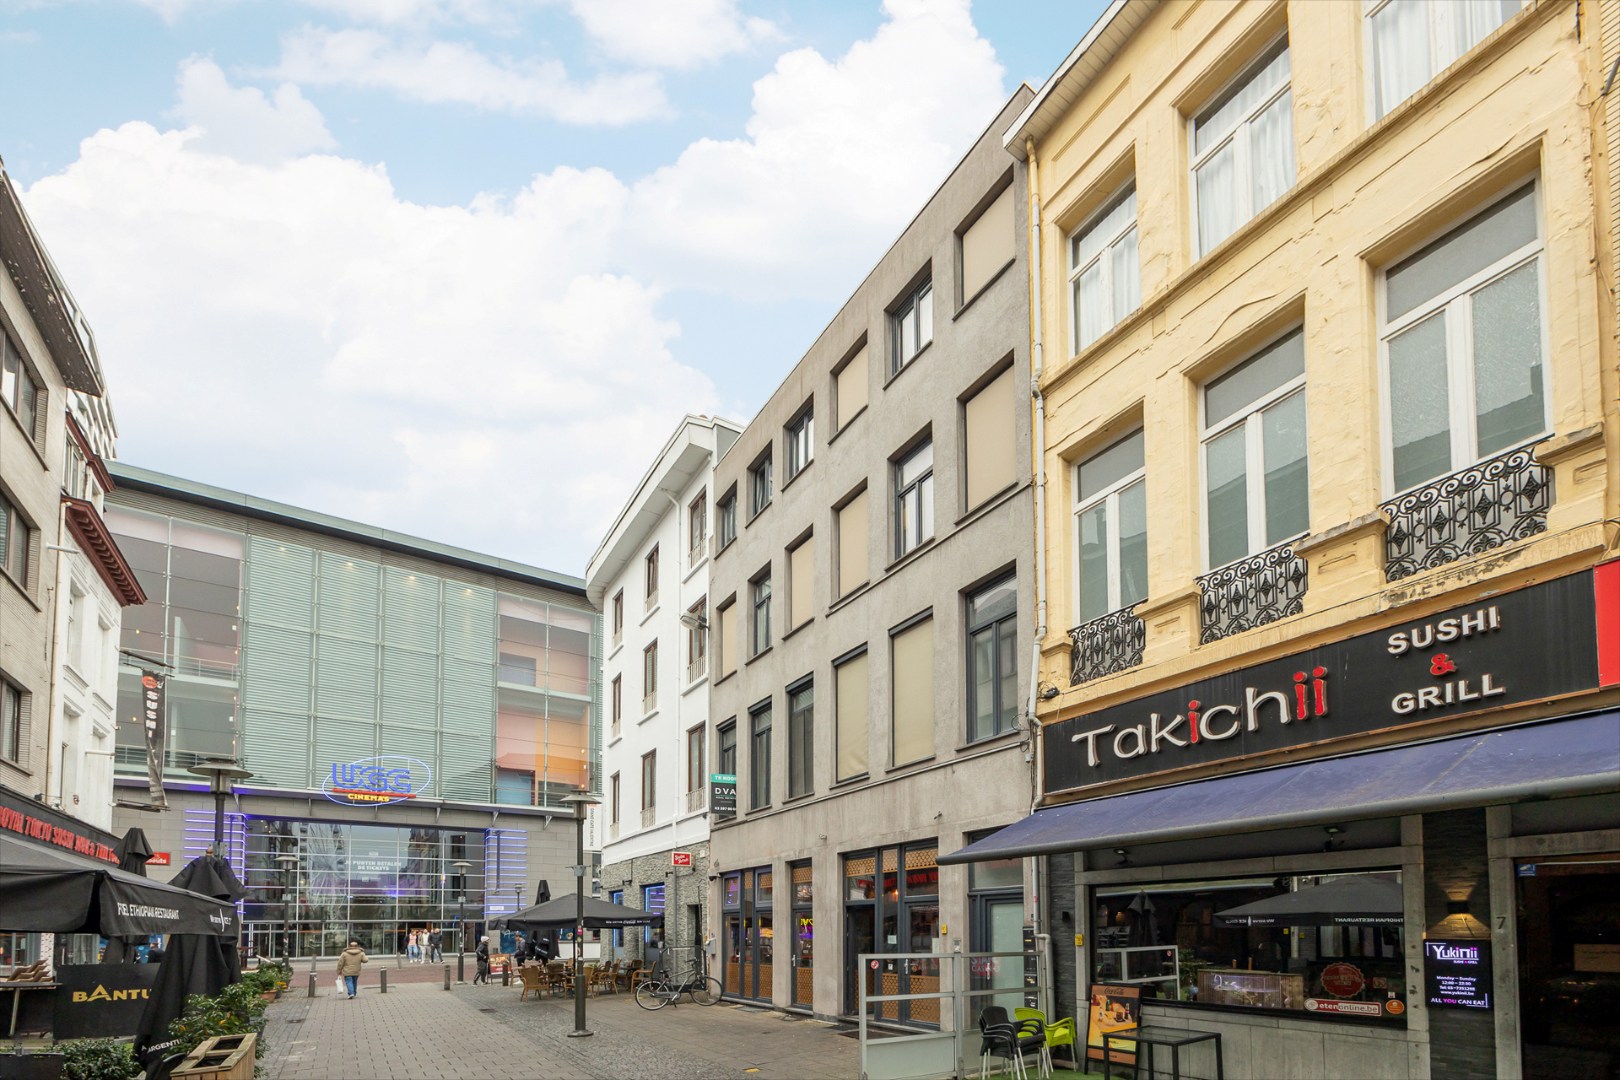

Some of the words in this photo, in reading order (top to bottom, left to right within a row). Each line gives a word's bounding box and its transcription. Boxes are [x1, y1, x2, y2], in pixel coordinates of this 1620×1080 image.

[1387, 605, 1500, 655] SUSHI
[1430, 653, 1457, 675] &
[1391, 673, 1506, 715] GRILL
[1071, 666, 1328, 767] Takichii
[1496, 916, 1506, 930] 7
[1319, 1002, 1378, 1013] etenonline.be
[147, 1039, 180, 1054] ARGENTI
